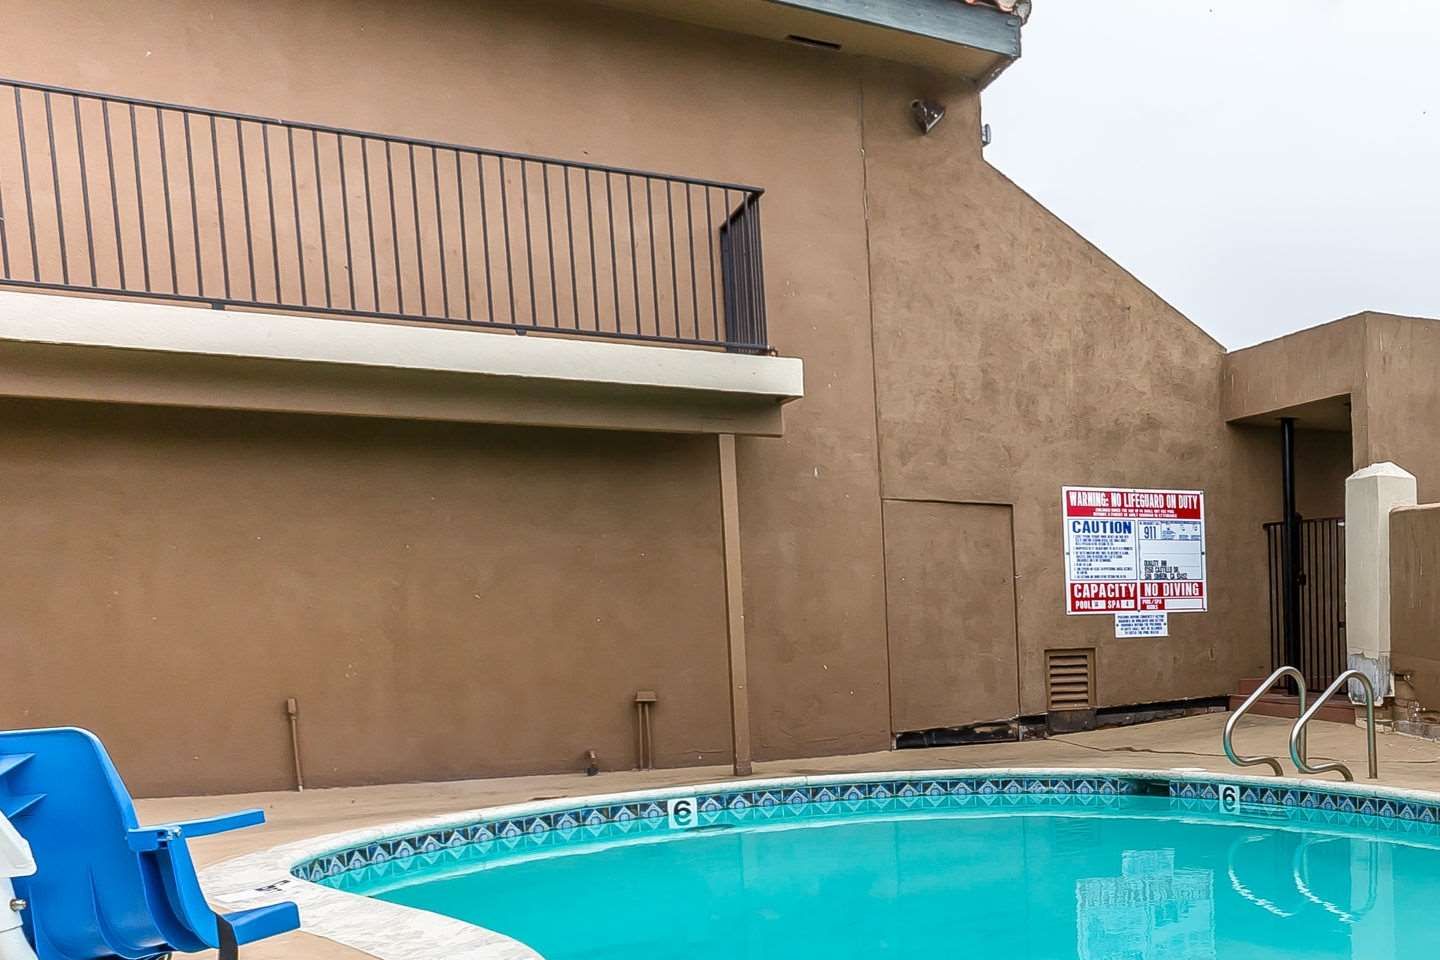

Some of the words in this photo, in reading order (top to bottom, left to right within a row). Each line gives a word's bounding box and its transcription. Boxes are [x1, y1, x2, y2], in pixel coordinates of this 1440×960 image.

[1069, 491, 1109, 507] WARNING:
[1111, 492, 1121, 508] NO
[1124, 492, 1164, 509] LIFEGUARD
[1166, 493, 1177, 509] ON
[1178, 494, 1198, 510] DUTY
[1072, 520, 1132, 534] CAUTION
[1144, 526, 1157, 539] 911
[1073, 583, 1136, 598] CAPACITY
[1144, 582, 1158, 597] NO
[1163, 582, 1200, 596] DIVING
[1075, 600, 1092, 609] POOL
[1107, 600, 1121, 609] SPA
[1222, 786, 1236, 811] 6
[673, 800, 692, 825] 6
